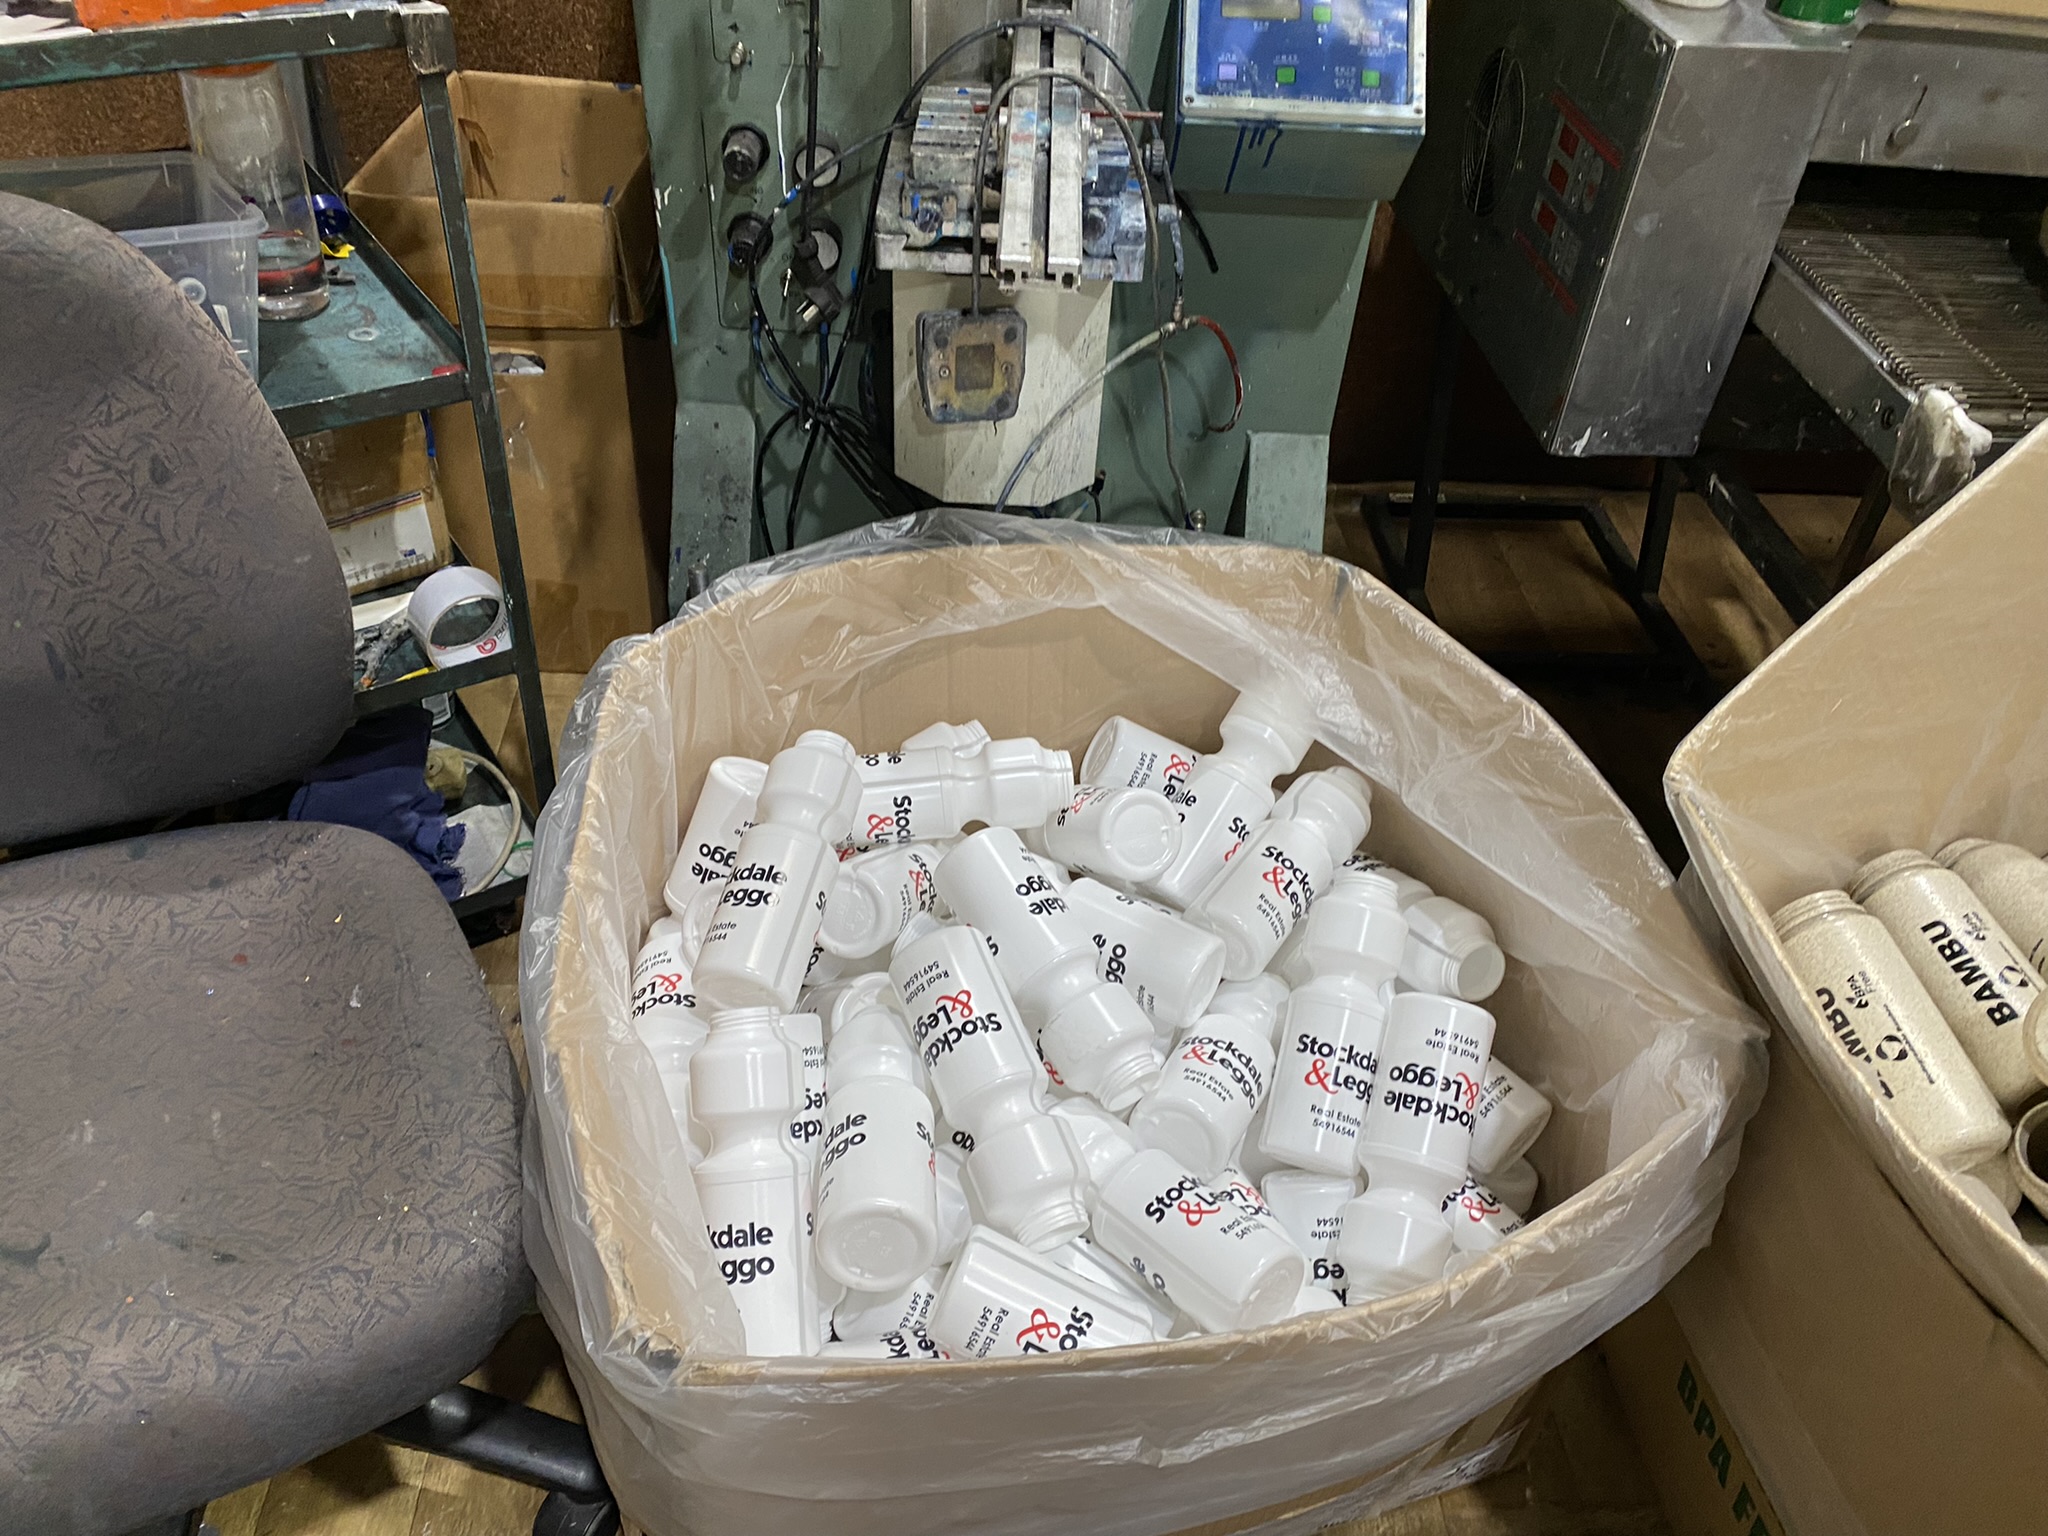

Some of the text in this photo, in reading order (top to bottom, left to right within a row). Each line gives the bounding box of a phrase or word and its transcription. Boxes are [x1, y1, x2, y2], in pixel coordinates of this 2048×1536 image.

[926, 969, 950, 988] Real
[1847, 974, 1865, 998] BPA
[1920, 920, 2019, 1027] BAMBU
[1179, 1034, 1263, 1098] Stockdale
[1183, 1067, 1235, 1101] Real Estate
[1310, 1104, 1362, 1128] Real Estate
[1383, 1089, 1477, 1138] tockdale
[1312, 1119, 1356, 1138] 54916544
[707, 1221, 774, 1249] kdale
[923, 1292, 935, 1320] Real
[993, 1307, 1010, 1337] Real
[1677, 1359, 1732, 1489] BPA
